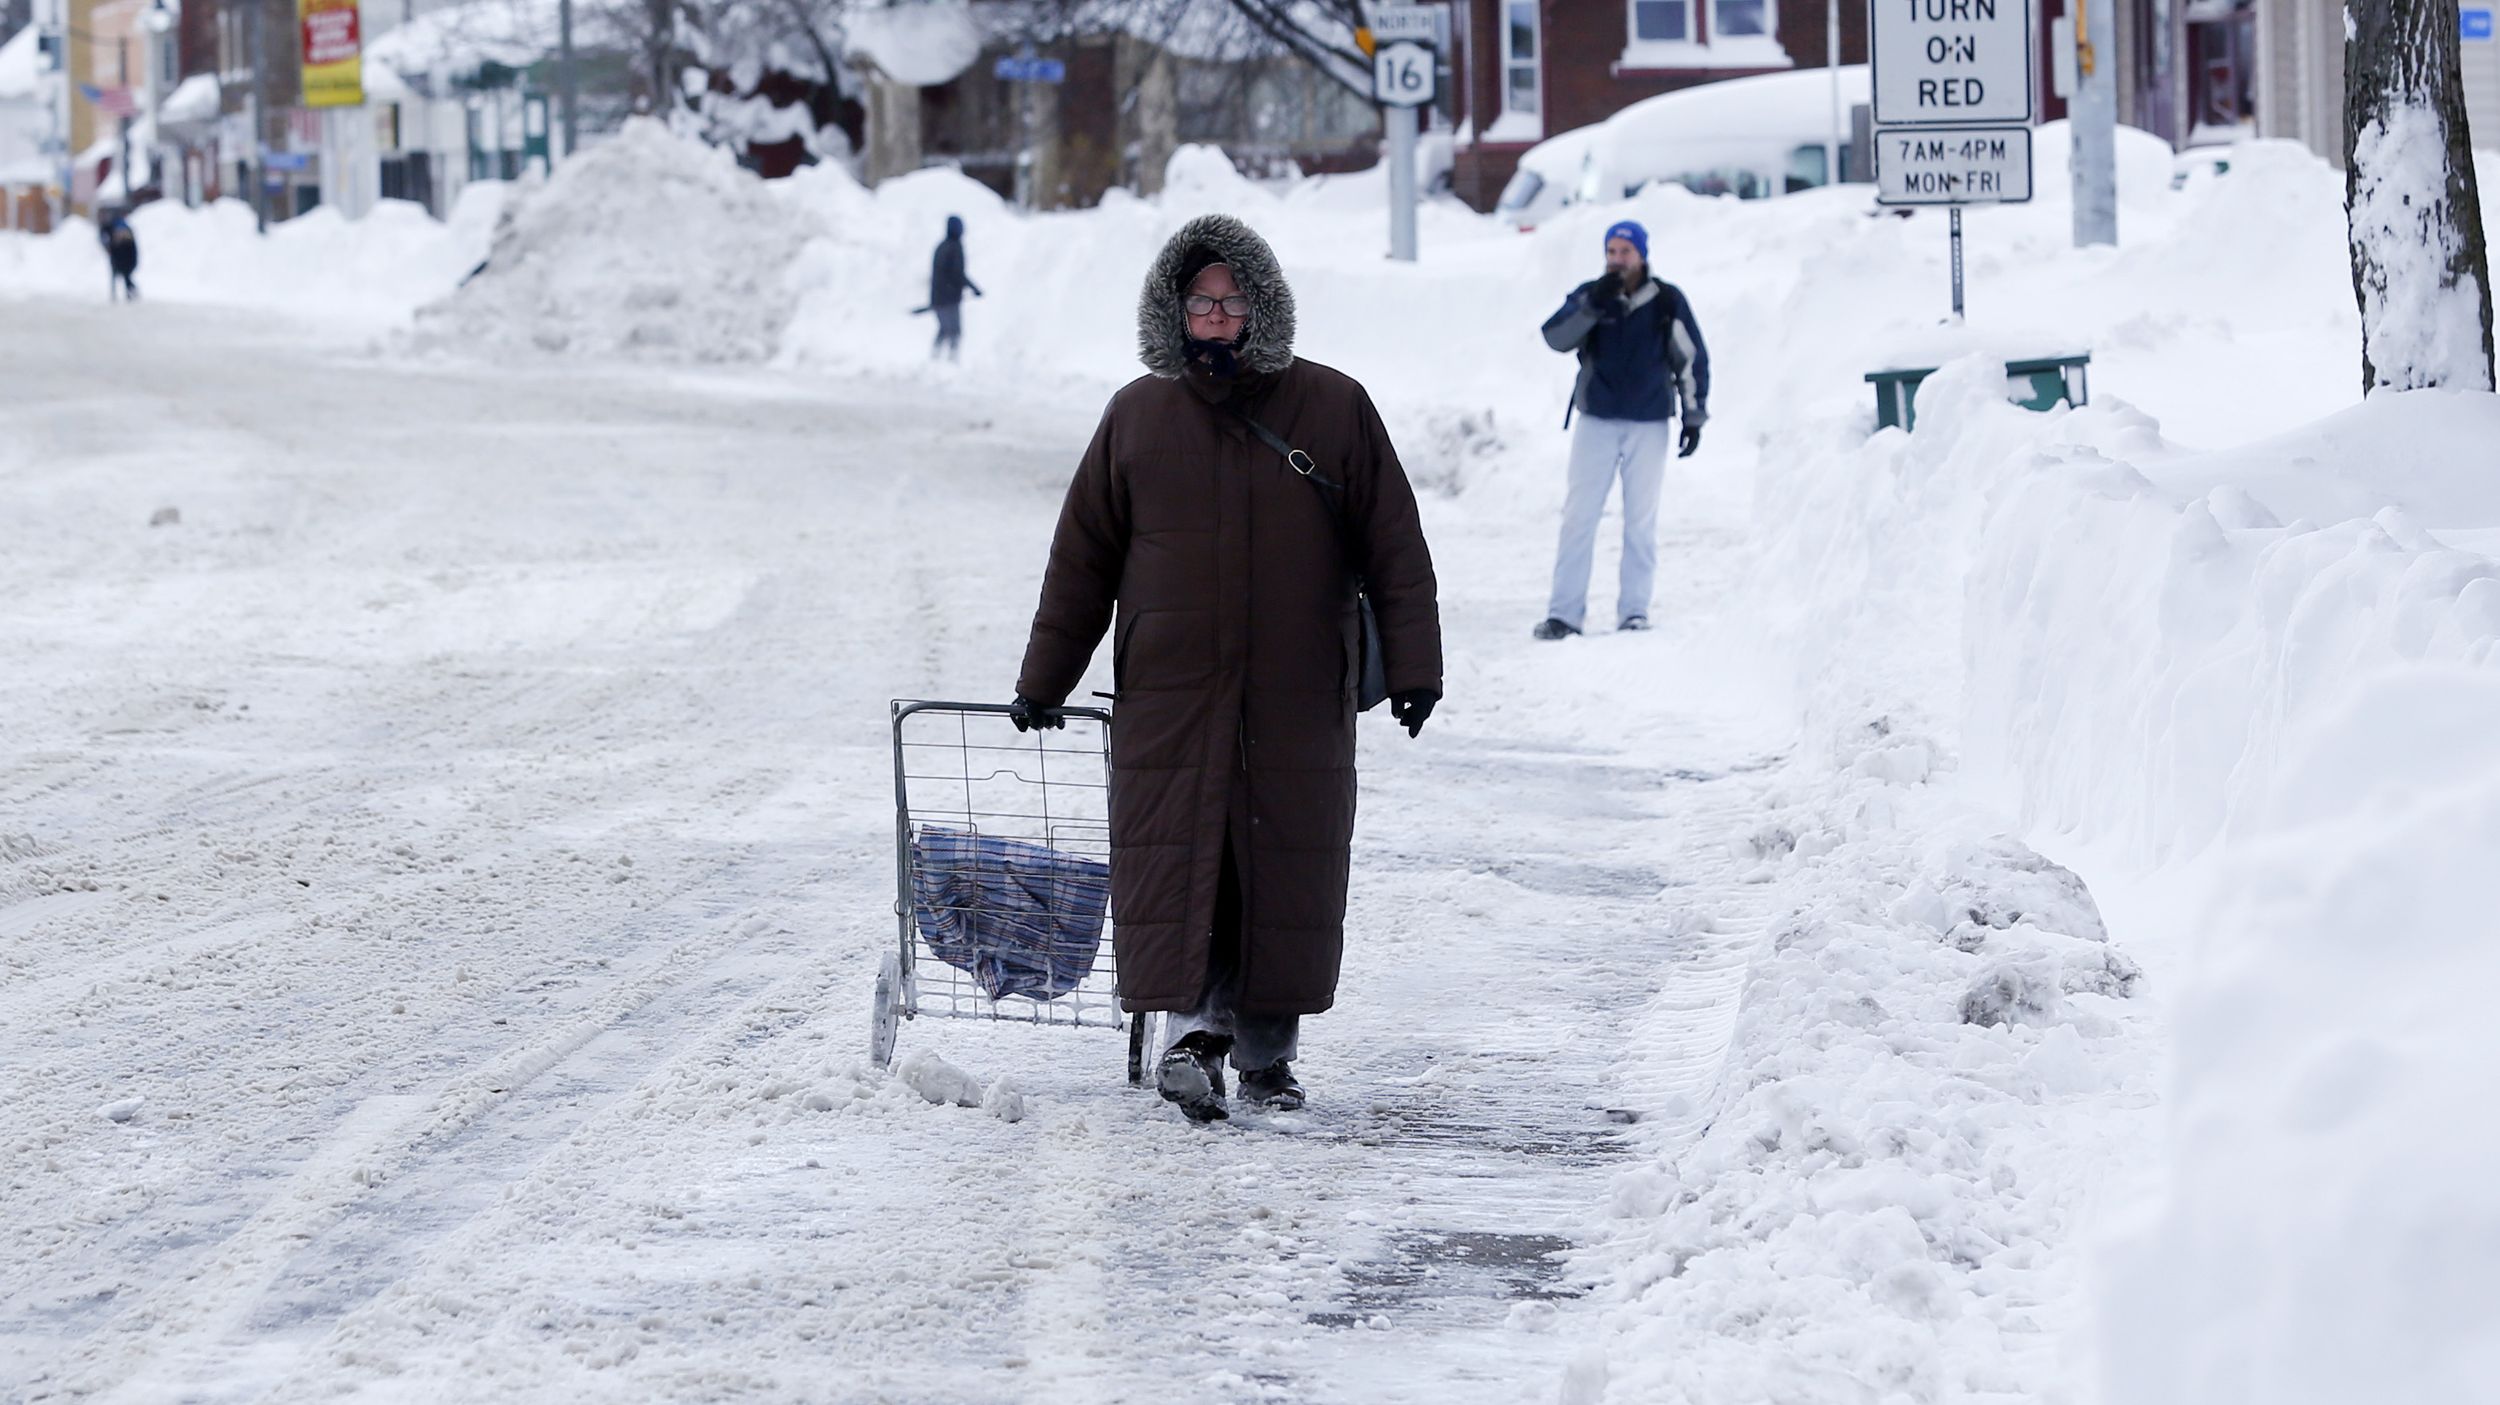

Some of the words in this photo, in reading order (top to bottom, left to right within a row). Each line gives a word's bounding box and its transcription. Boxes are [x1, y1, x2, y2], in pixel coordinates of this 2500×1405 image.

[1378, 15, 1432, 29] NORTH
[1906, 0, 1995, 21] TURN
[1926, 36, 1975, 64] ON
[1387, 59, 1422, 91] 16
[1918, 79, 1984, 107] RED
[1899, 139, 2006, 161] 7AM-4PM
